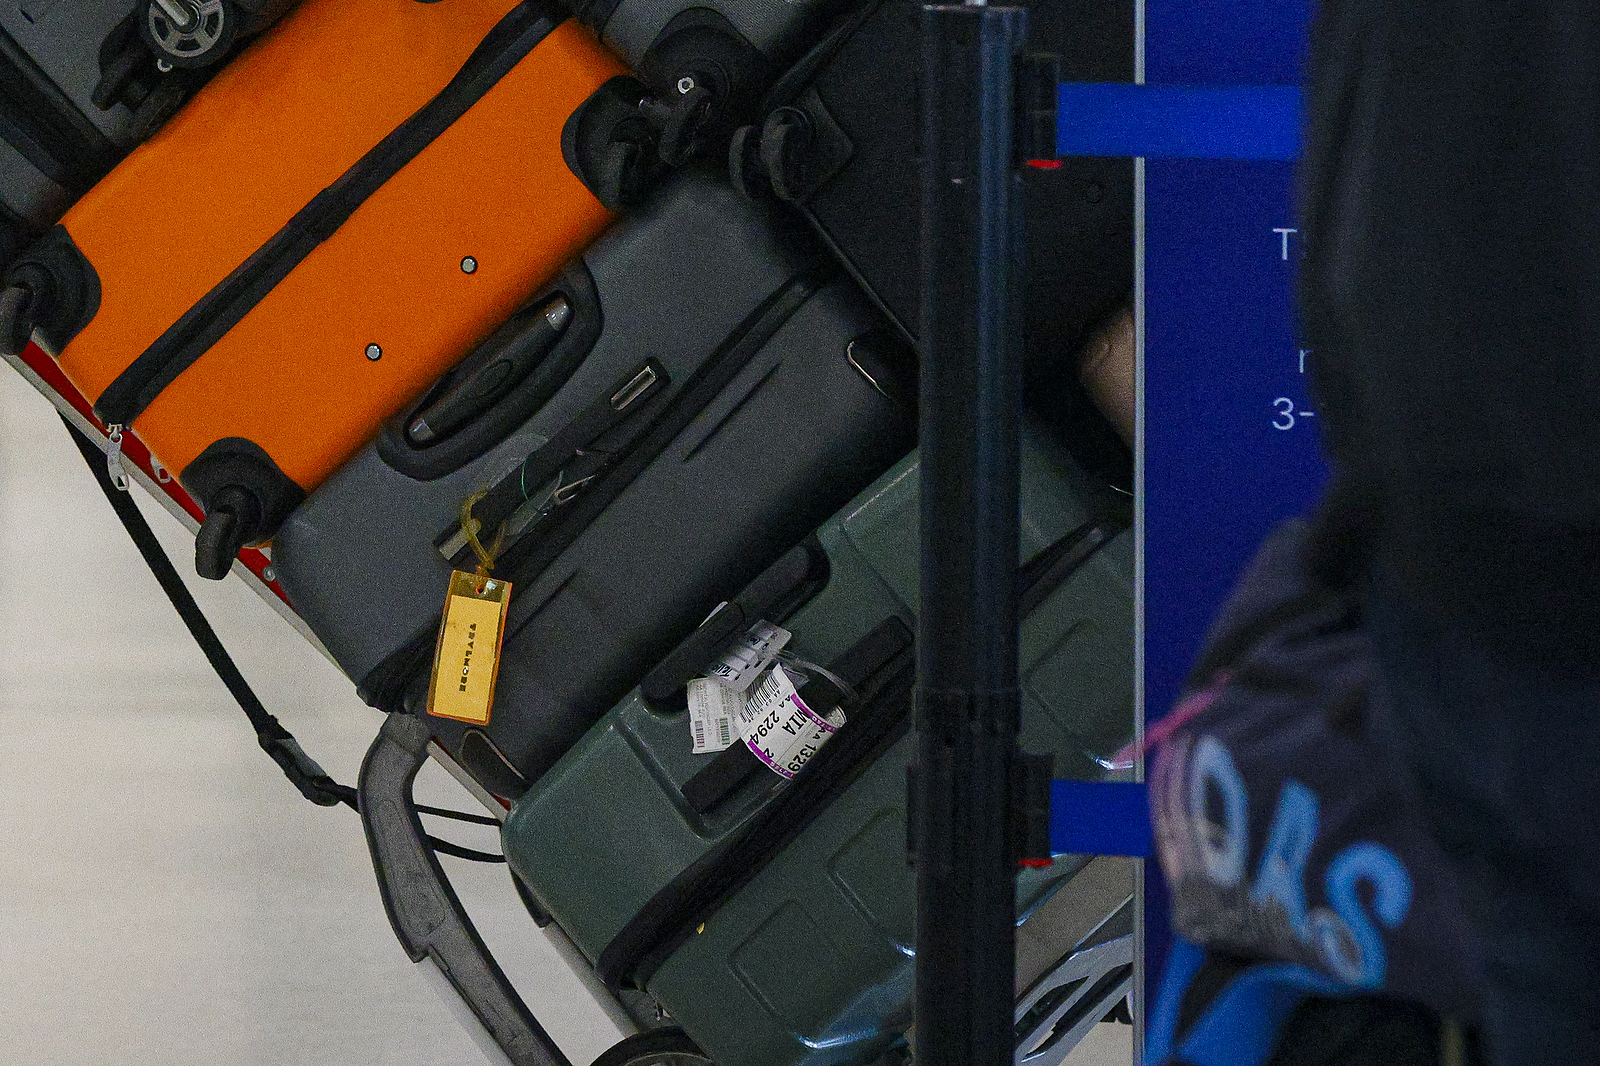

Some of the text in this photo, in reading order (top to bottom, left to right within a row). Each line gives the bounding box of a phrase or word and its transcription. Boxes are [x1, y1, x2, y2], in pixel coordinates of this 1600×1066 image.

[750, 710, 780, 745] 2294
[782, 707, 810, 735] MIA
[787, 744, 817, 772] 1329
